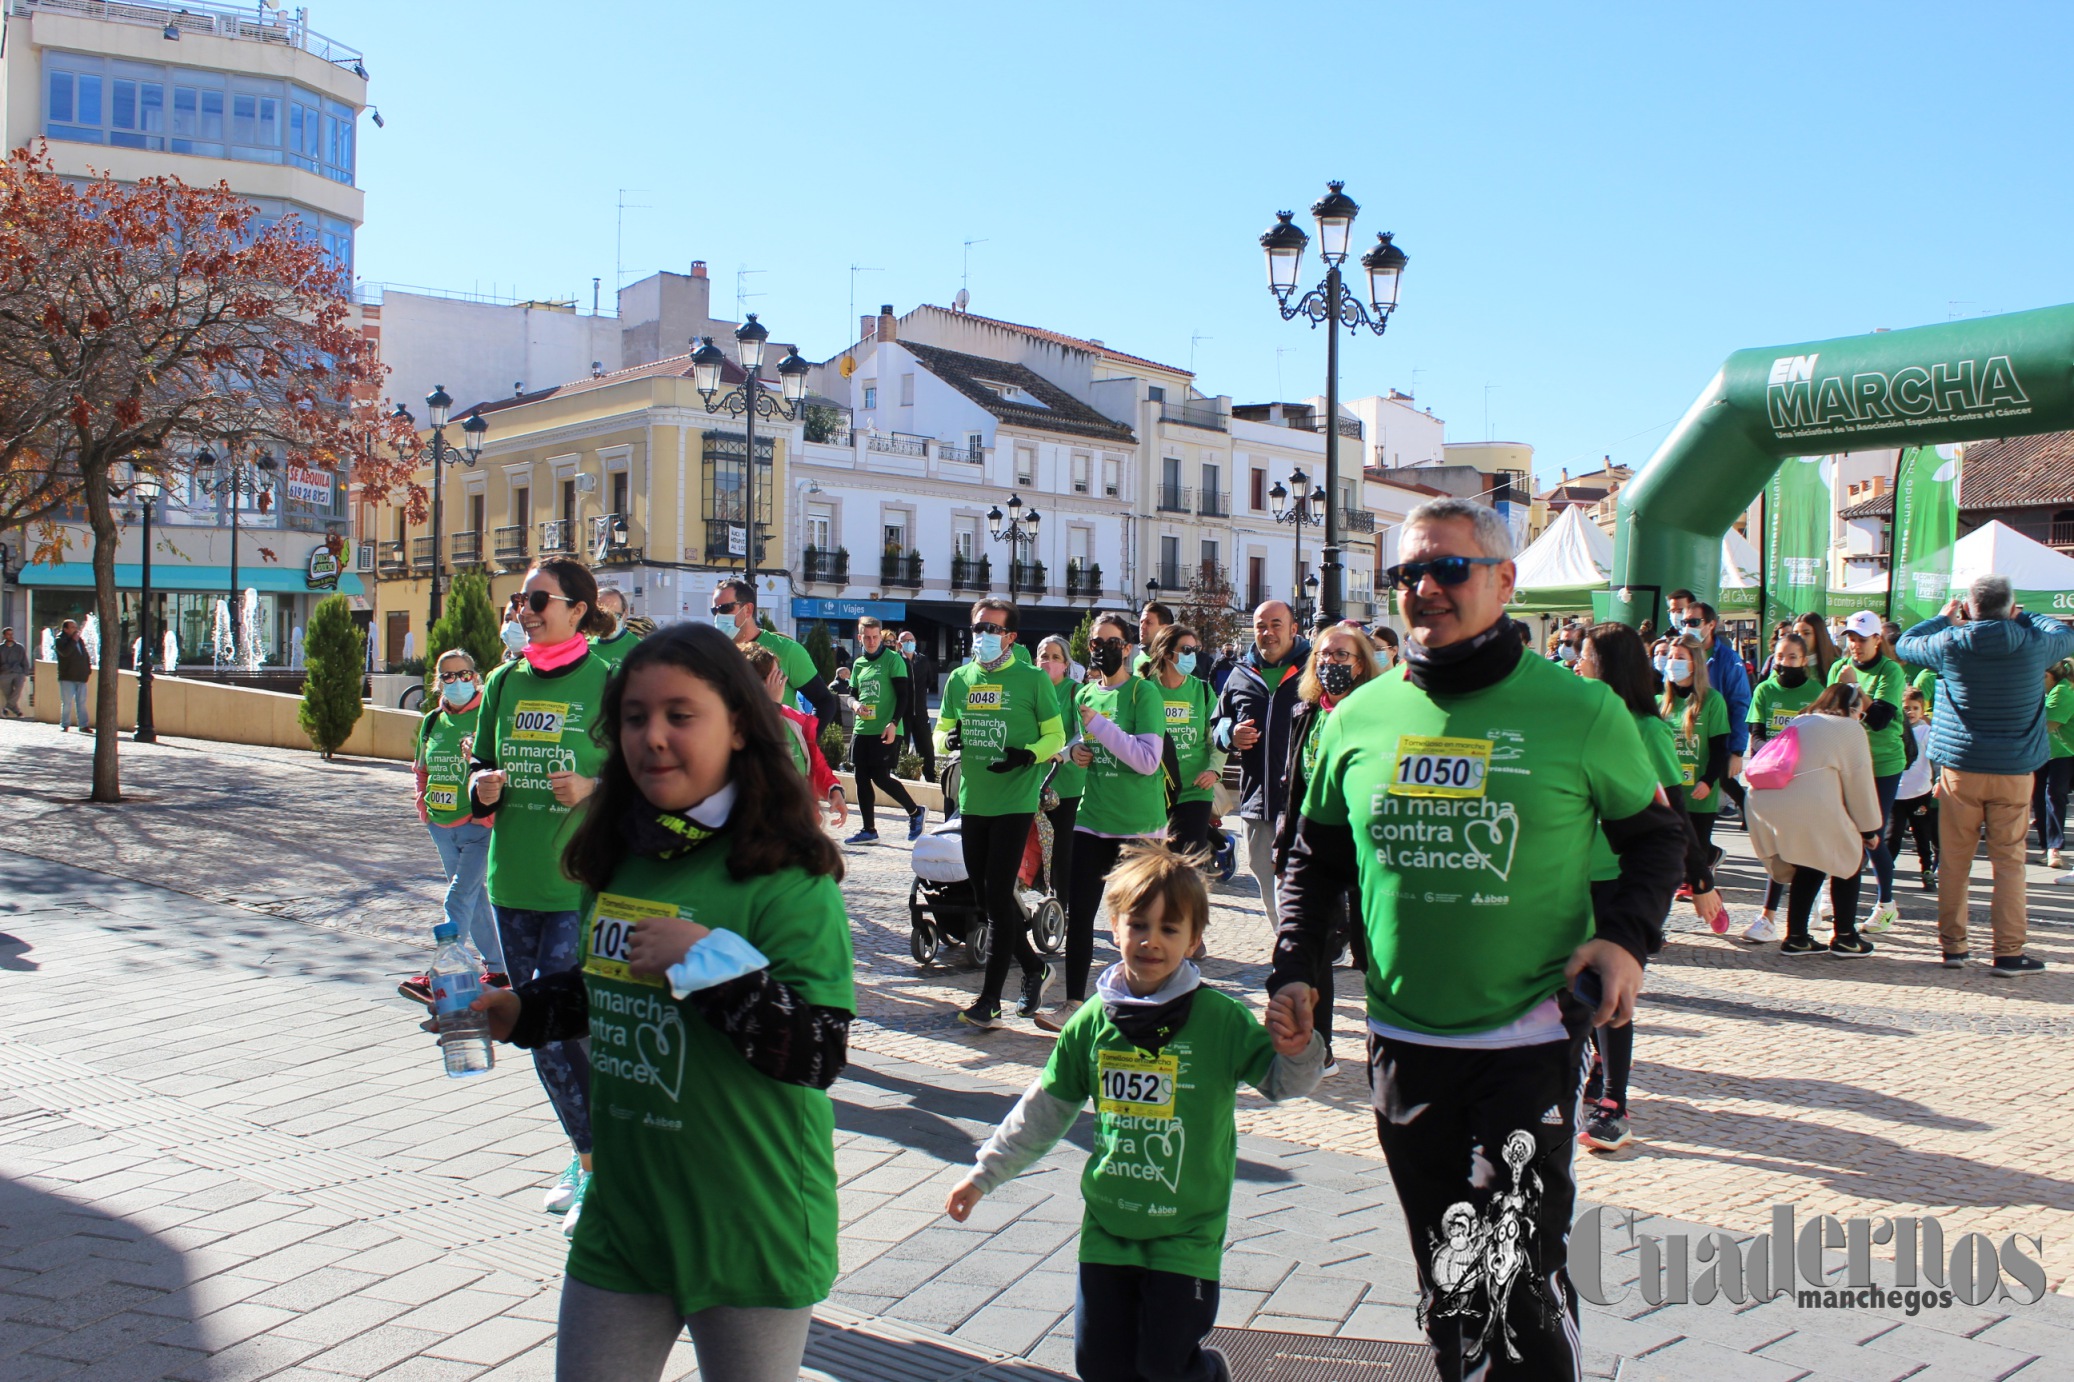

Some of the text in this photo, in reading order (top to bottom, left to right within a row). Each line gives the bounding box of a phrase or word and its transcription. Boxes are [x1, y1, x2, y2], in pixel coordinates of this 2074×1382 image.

[1768, 353, 1819, 385] EN
[1767, 355, 2030, 429] MARCHA
[1775, 406, 2032, 439] Una iniciativa de la Asociación Española Contra el Cáncer
[290, 466, 299, 482] SE
[290, 485, 302, 497] 619
[303, 488, 312, 499] 24
[1904, 479, 1913, 524] cuando
[1770, 513, 1779, 585] escucharte
[1898, 529, 1909, 598] escucharte
[843, 603, 865, 615] Viajes
[1767, 602, 1778, 626] Voy
[969, 692, 996, 704] 0048
[515, 711, 556, 731] 0002
[1165, 707, 1184, 718] 087
[1773, 715, 1792, 726] 106
[961, 728, 987, 737] contra
[971, 718, 1007, 730] marcha
[502, 743, 575, 759] En marcha
[968, 737, 998, 748] cáncer
[1455, 742, 1486, 751] marcha
[432, 773, 460, 782] cáncer
[1398, 756, 1470, 787] 1050
[513, 776, 554, 791] cánce
[430, 791, 453, 804] 0012
[1370, 793, 1516, 819] En marcha
[1370, 820, 1454, 843] contra
[1376, 844, 1492, 870] el cáncer
[593, 919, 637, 961] 105
[594, 988, 680, 1023] marcha
[1102, 1054, 1133, 1063] Tomelloso
[1101, 1070, 1160, 1103] 1052
[1105, 1112, 1183, 1132] marcha
[1157, 1205, 1178, 1215] ábea
